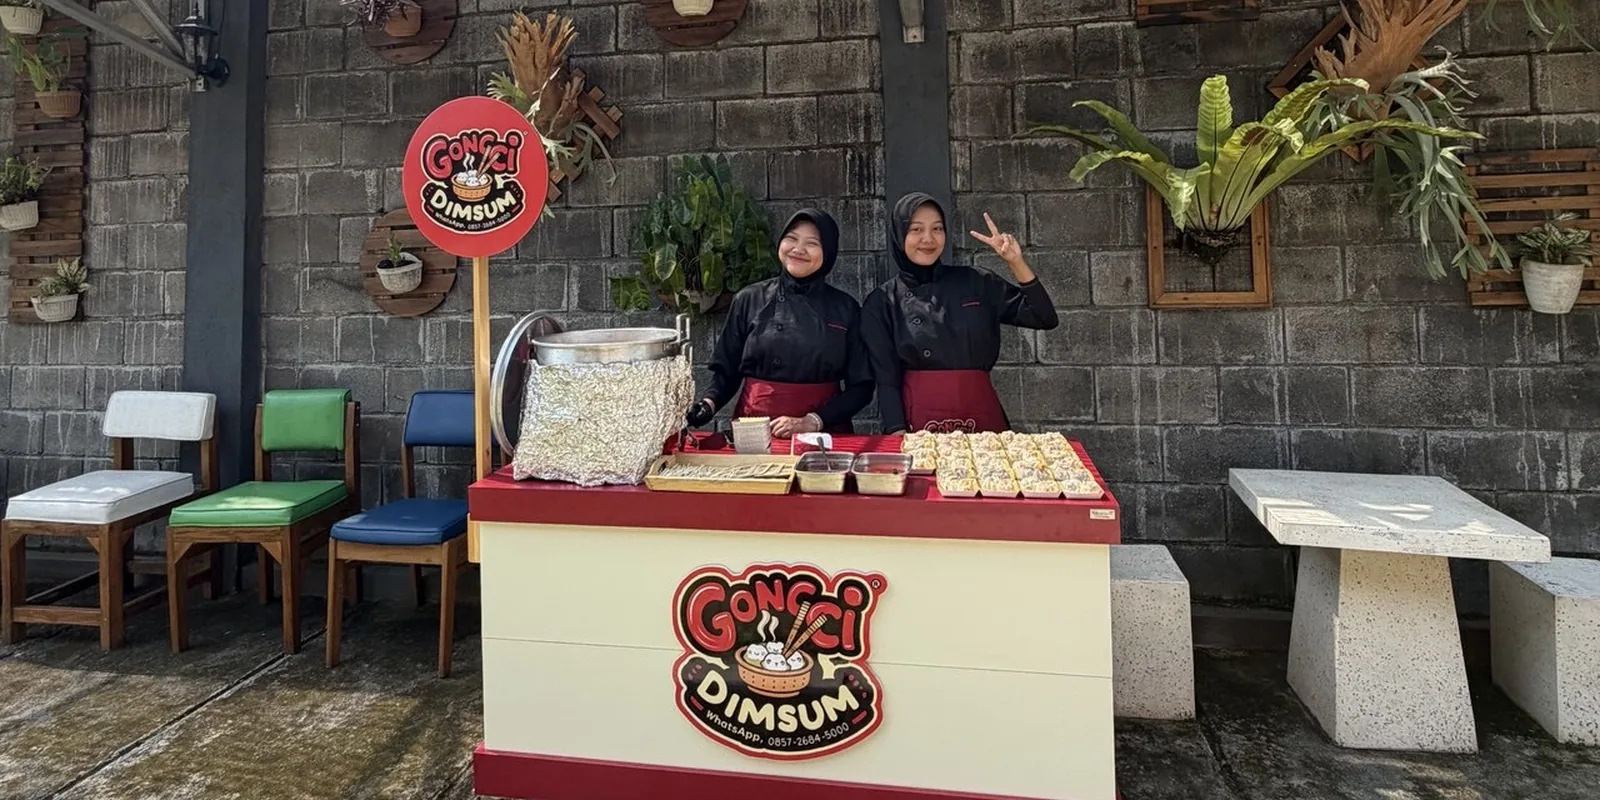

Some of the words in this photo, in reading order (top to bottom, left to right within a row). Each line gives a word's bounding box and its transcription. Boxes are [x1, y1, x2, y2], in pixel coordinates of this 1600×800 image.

[430, 189, 517, 221] DIMSUM
[696, 669, 860, 733] DIMSUM
[768, 722, 850, 747] 0857-2684-5000
